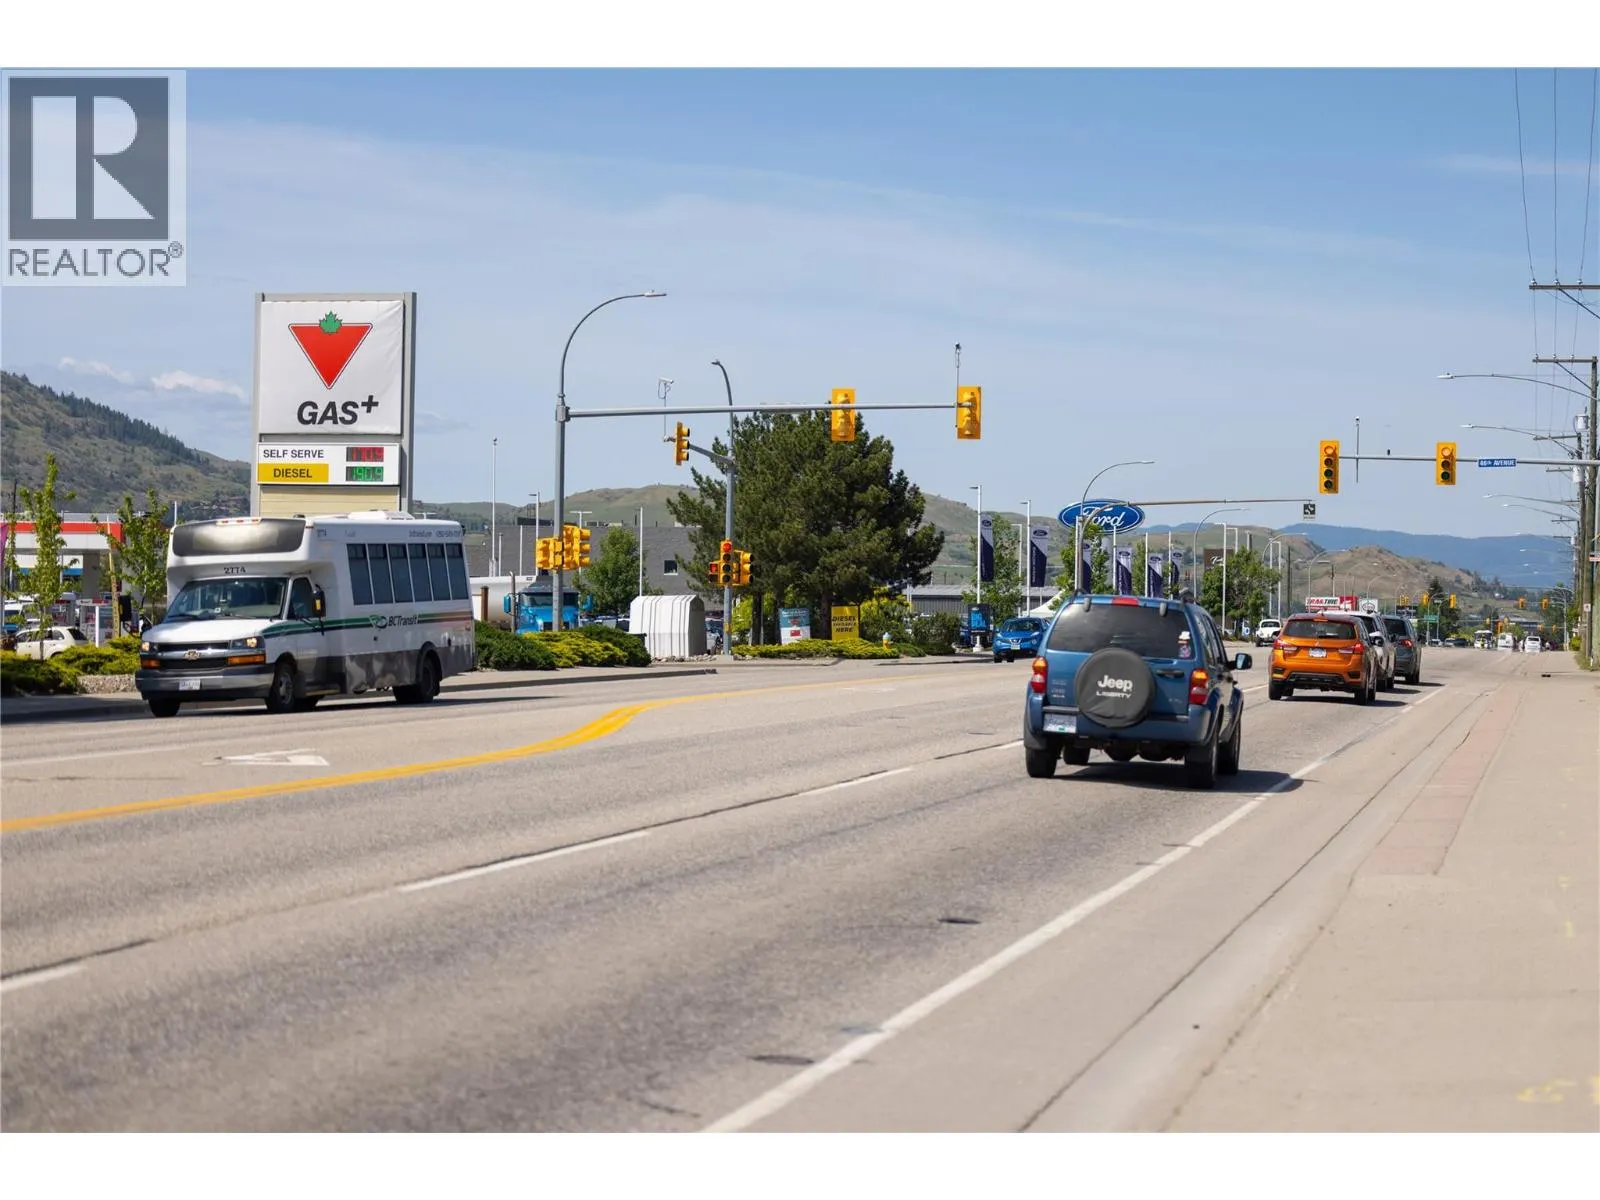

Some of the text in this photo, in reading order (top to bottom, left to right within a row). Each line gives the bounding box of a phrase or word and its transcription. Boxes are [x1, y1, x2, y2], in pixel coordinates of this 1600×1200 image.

[263, 449, 324, 459] SELF SERVE
[273, 468, 312, 478] DIESEL
[224, 566, 246, 574] 2774
[1097, 674, 1134, 692] Jeep
[1095, 690, 1132, 698] LIBERTY
